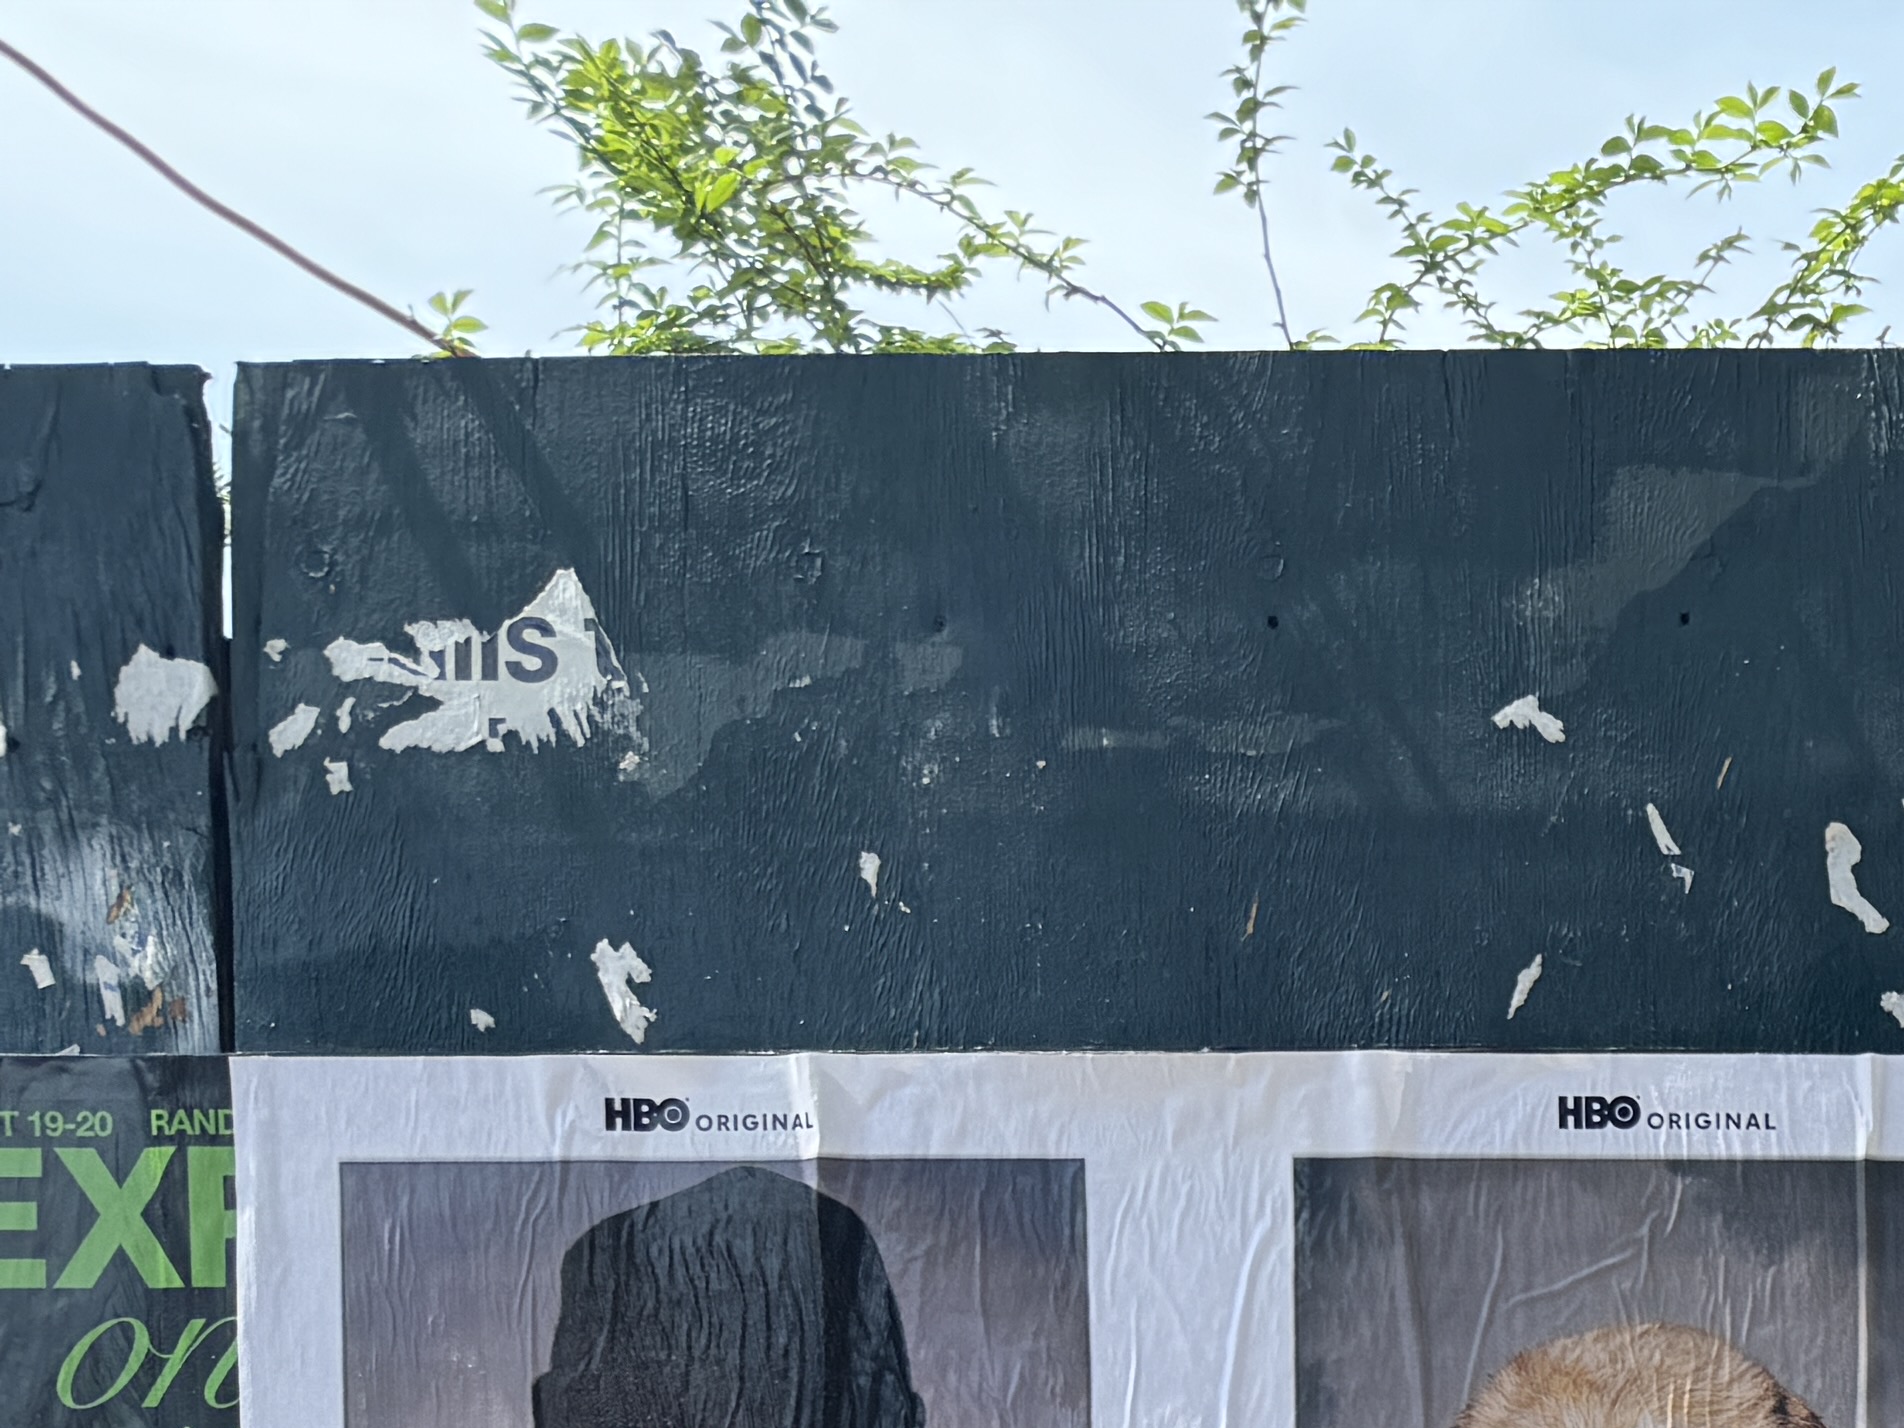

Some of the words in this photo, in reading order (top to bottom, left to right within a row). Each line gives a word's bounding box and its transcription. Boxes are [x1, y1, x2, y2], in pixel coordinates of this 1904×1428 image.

[27, 1111, 113, 1137] 19-20
[605, 1097, 689, 1132] HBO
[695, 1112, 814, 1132] ORIGINAL
[1558, 1096, 1641, 1130] HBO
[1647, 1112, 1776, 1131] ORIGINAL
